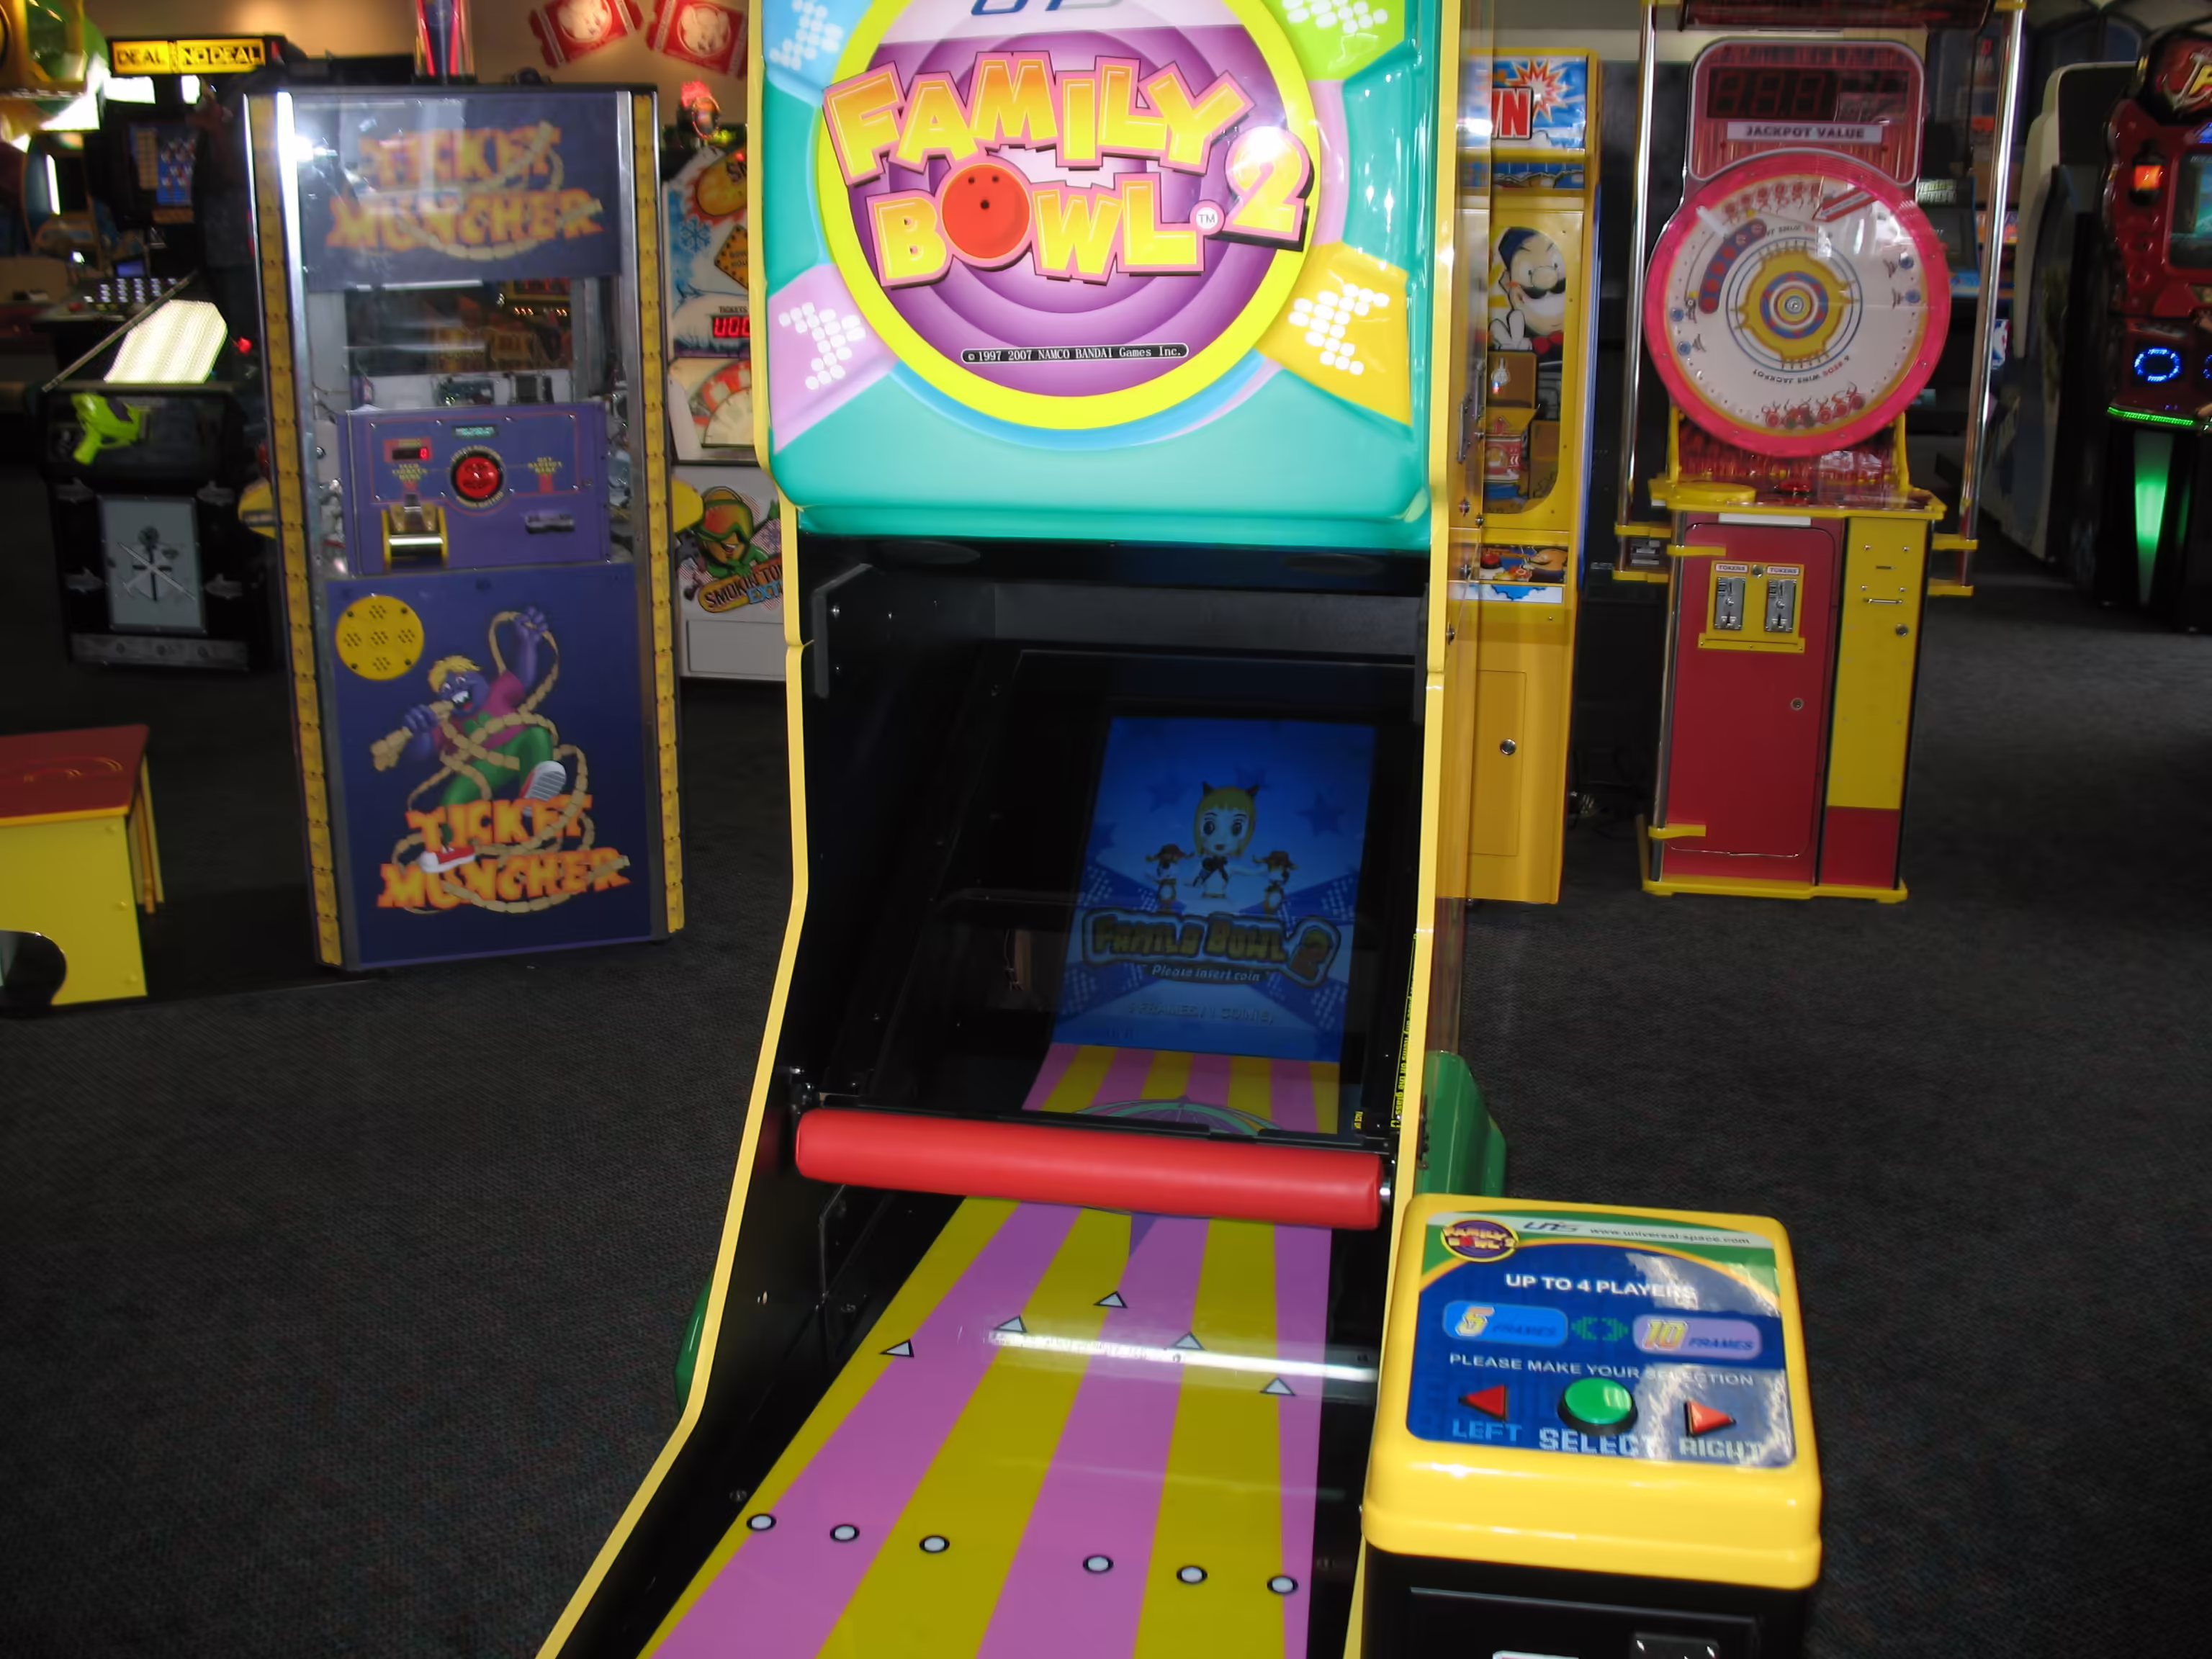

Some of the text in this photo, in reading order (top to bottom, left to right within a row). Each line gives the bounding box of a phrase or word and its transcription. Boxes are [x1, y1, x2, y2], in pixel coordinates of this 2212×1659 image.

[823, 50, 1255, 186] FAMILY
[1745, 125, 1865, 139] JACKPOT VALUE
[866, 156, 1205, 289] BOWL
[1224, 125, 1315, 252] 2
[1007, 349, 1033, 361] 2007
[1038, 349, 1071, 360] NAMCO
[1074, 347, 1113, 359] BANDAI
[1118, 346, 1152, 358] Games
[1159, 346, 1182, 357] Inc.
[405, 793, 593, 853] TICKET
[377, 847, 634, 910] MUNCHER
[1152, 964, 1260, 981] Please insert coin
[1505, 1273, 1697, 1299] UP TO 4 PLAYERS
[1455, 1305, 1495, 1337] 5
[1641, 1318, 1754, 1351] 10 FRAMES
[1449, 1352, 1522, 1370] PLEASE
[1527, 1359, 1581, 1375] MAKE
[1586, 1363, 1640, 1378] YOUR
[1452, 1419, 1763, 1463] LEFT SELECT RIGHT
